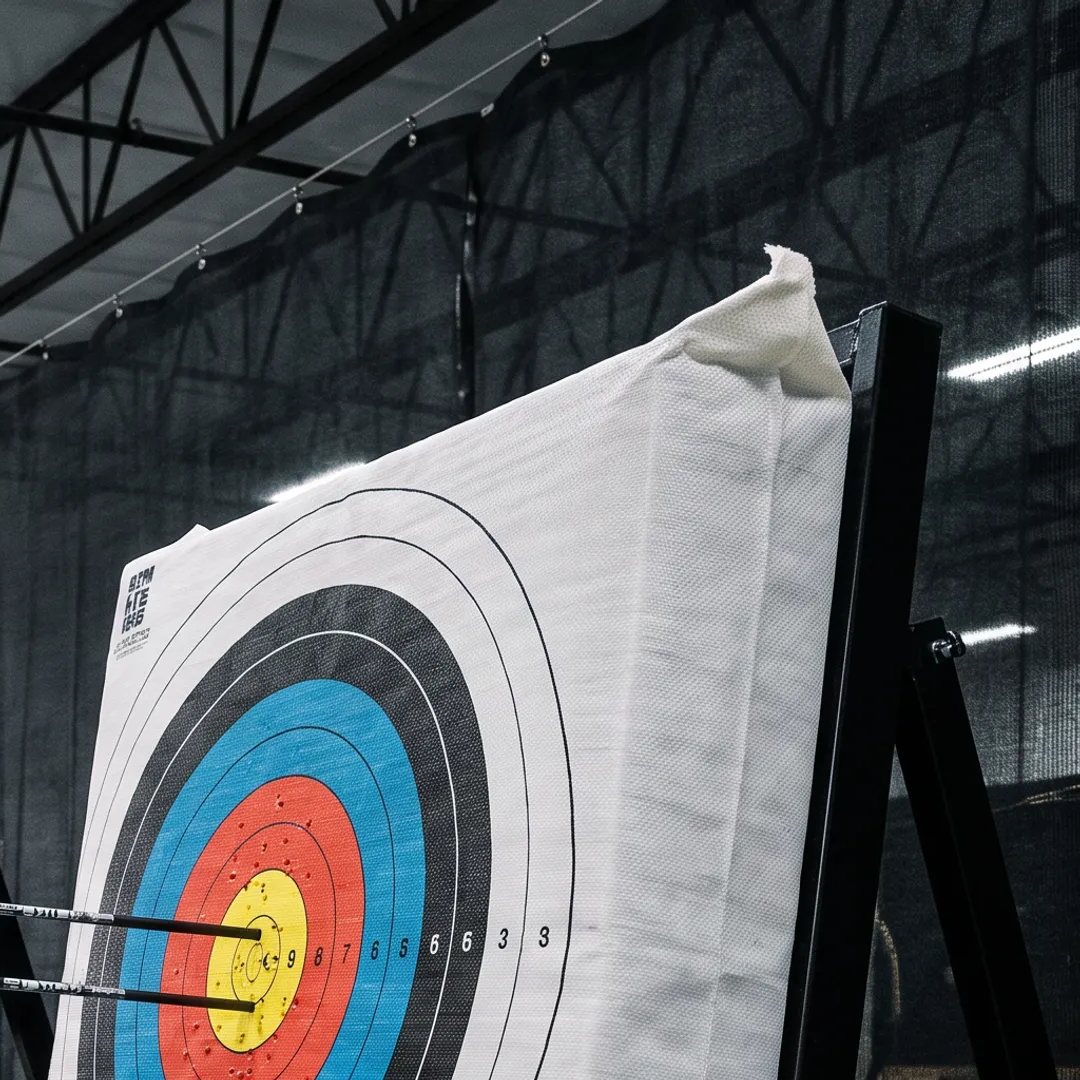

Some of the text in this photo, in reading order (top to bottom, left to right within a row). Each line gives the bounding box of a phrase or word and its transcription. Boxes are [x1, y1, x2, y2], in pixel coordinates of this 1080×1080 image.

[287, 949, 296, 969] 9
[314, 946, 323, 967] 8
[342, 943, 351, 964] 7
[370, 940, 380, 961] 6
[429, 933, 440, 955] 6
[461, 931, 473, 953] 6
[497, 927, 509, 949] 3
[538, 925, 550, 948] 3
